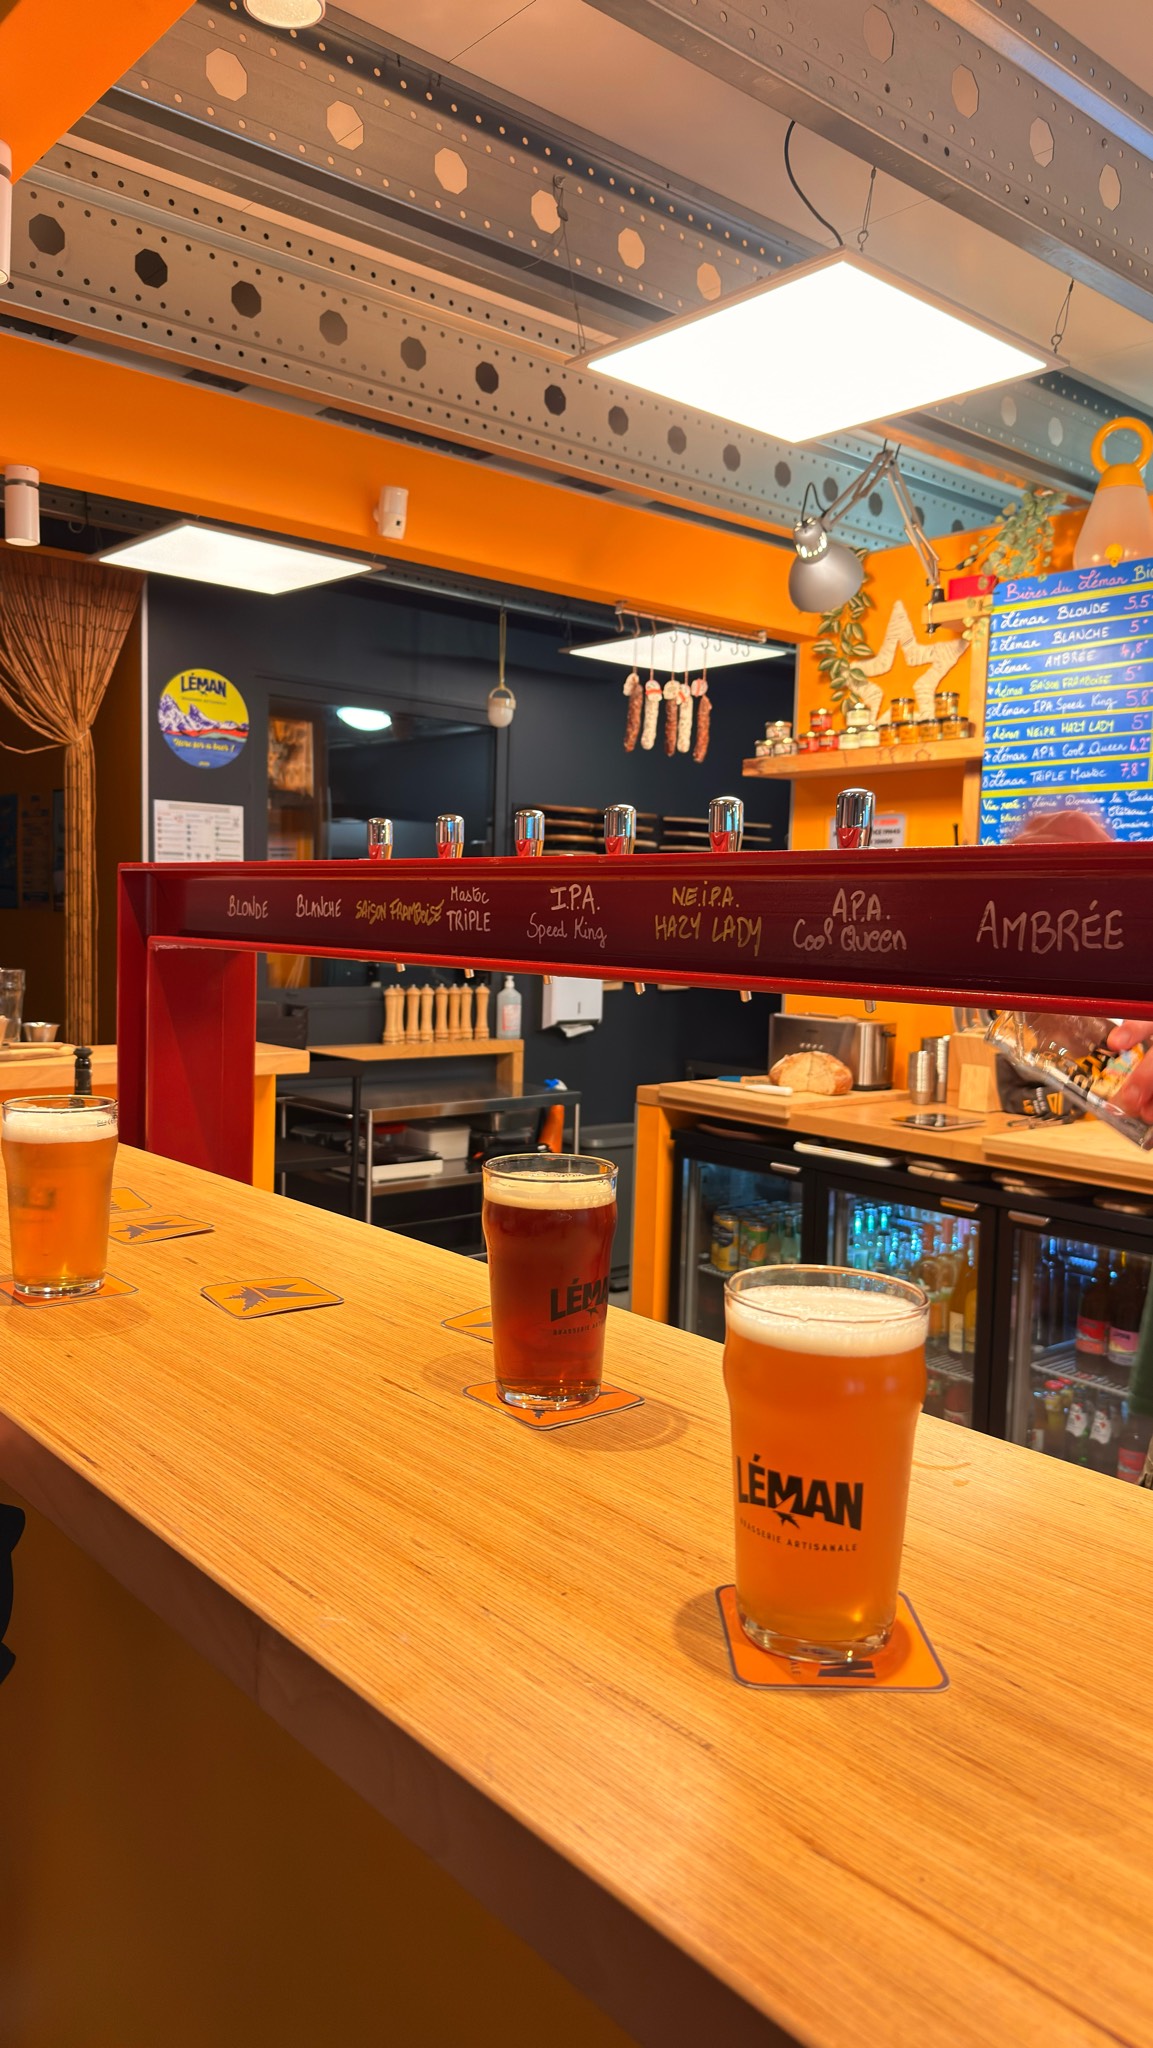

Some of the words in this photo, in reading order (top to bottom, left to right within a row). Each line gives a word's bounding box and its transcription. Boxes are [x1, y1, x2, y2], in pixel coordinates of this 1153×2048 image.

[1004, 583, 1048, 602] Bières
[1051, 580, 1073, 596] du
[1078, 569, 1128, 591] Léman
[1001, 611, 1049, 629] Léman
[1057, 602, 1110, 620] BLONDE
[991, 639, 998, 652] 2
[1000, 635, 1041, 651] Léman
[1051, 626, 1110, 645] BLANCHE
[995, 659, 1031, 675] Léman
[1045, 649, 1097, 668] AMBRÉE
[181, 673, 226, 698] LÉMAN
[1088, 719, 1115, 733] LADY
[992, 746, 1028, 763] Léman
[1062, 743, 1085, 757] Cool
[1087, 741, 1128, 755] Queen
[988, 770, 1027, 787] Léman
[227, 895, 269, 919] BLONDE
[296, 893, 342, 918] BLANCHE
[450, 886, 490, 904] Mastoc
[550, 884, 601, 915] I.P.A.
[832, 888, 891, 923] A.P.A.
[526, 912, 568, 944] Speed
[573, 916, 607, 948] King
[654, 911, 701, 941] HAZY
[711, 914, 762, 957] LADY
[792, 918, 834, 951] Cool
[840, 925, 908, 953] Queen
[976, 900, 1125, 954] AMBRÉE
[736, 1453, 864, 1531] LÉMAN
[786, 1538, 858, 1552] ARTISANALE
